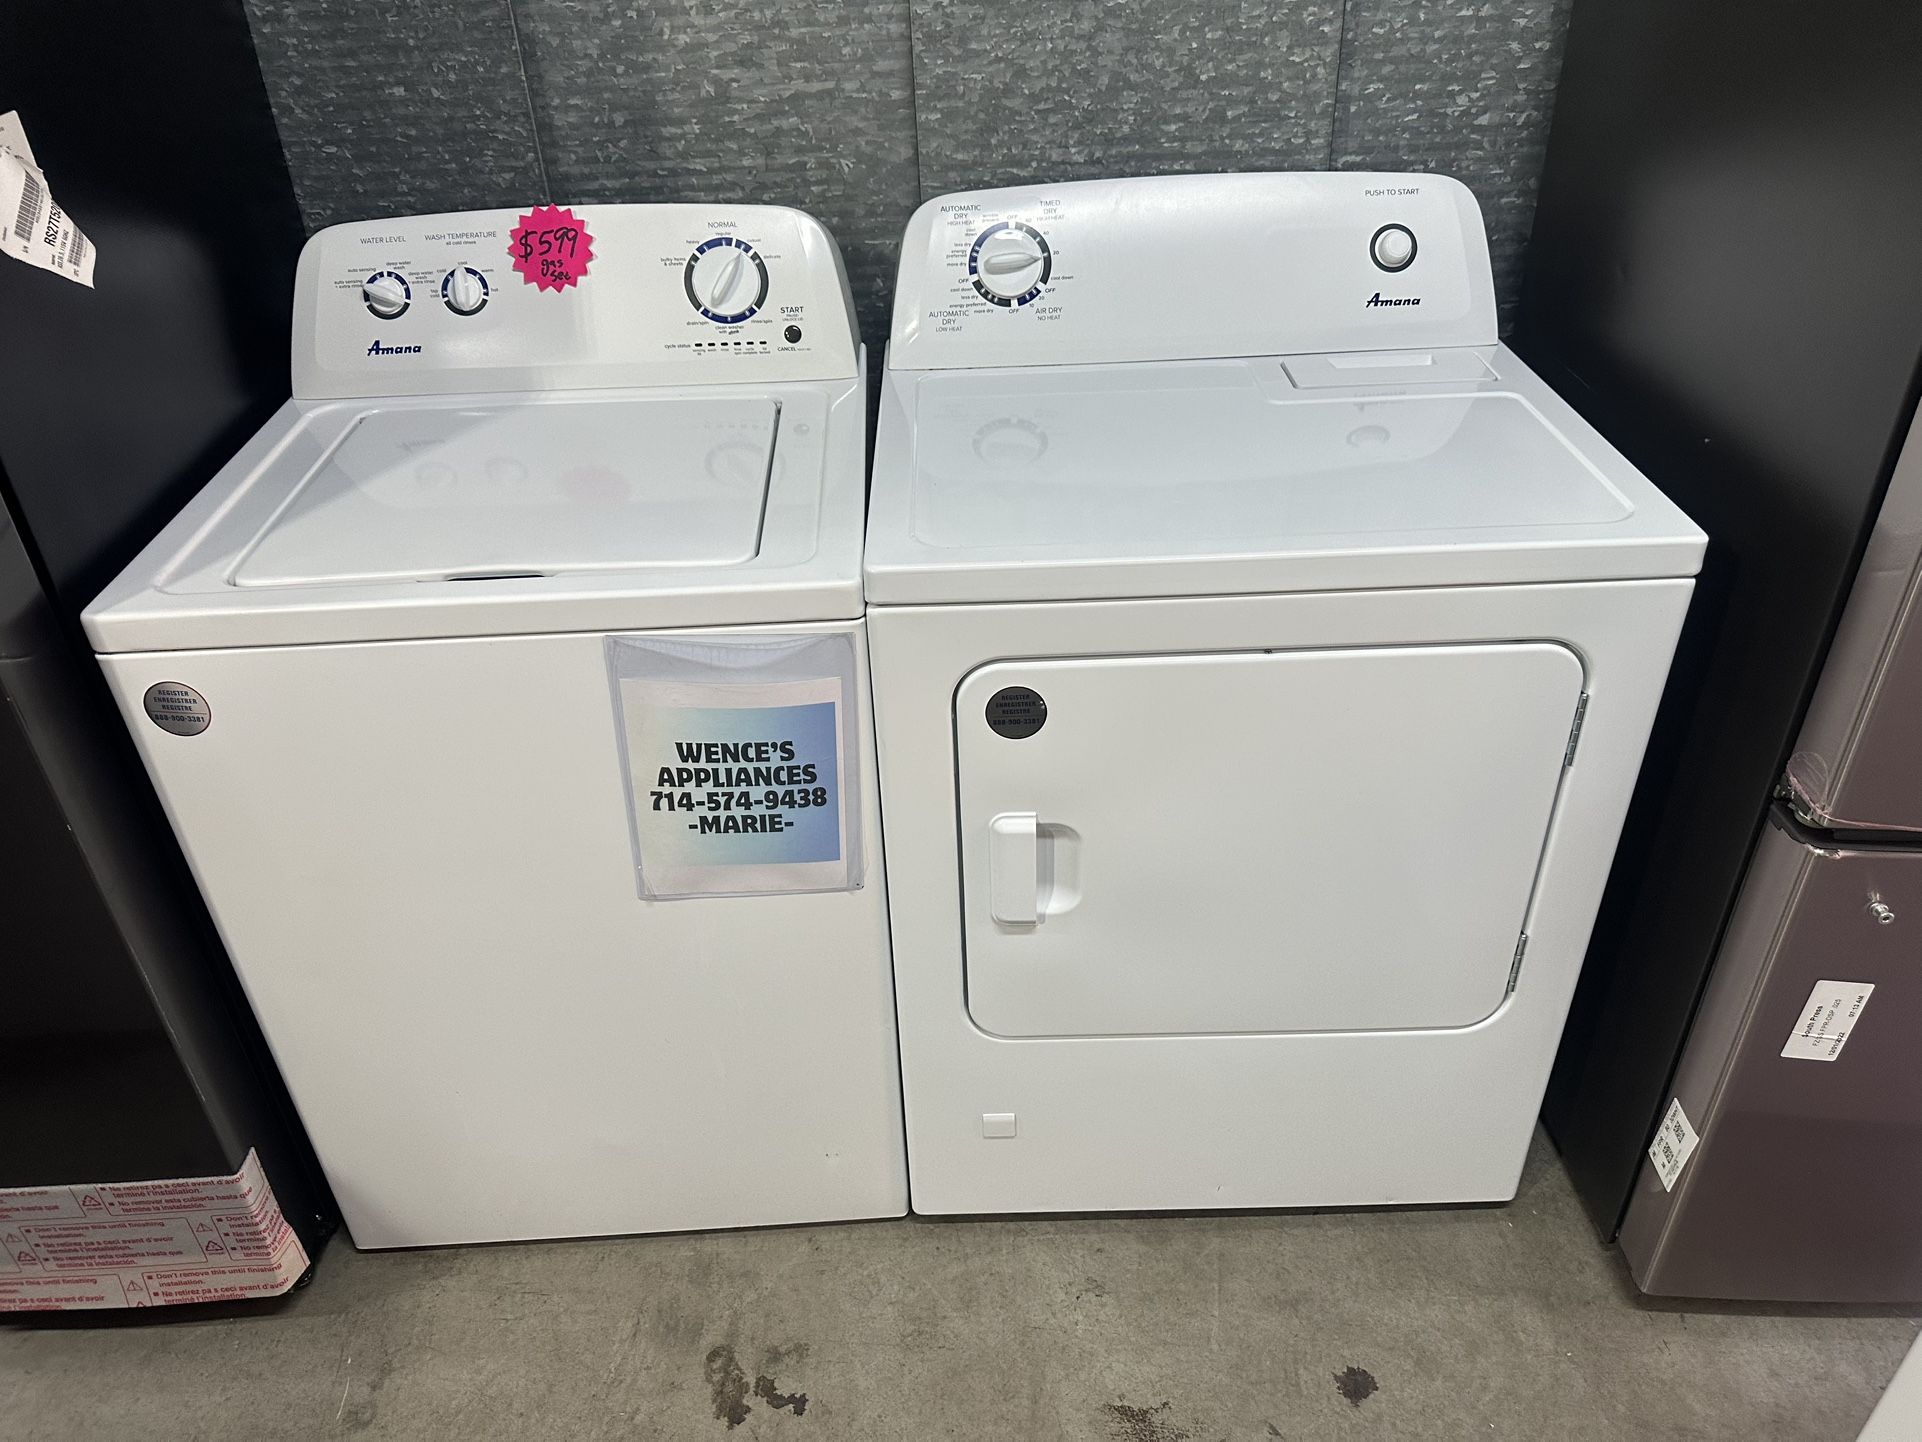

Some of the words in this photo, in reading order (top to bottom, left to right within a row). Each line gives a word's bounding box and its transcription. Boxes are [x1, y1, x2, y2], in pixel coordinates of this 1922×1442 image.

[1364, 189, 1385, 197] PUSH
[448, 231, 497, 240] TEMPERATURE
[518, 226, 579, 263] $599
[540, 258, 564, 277] gas
[550, 270, 571, 282] set
[1365, 292, 1421, 308] Amana
[928, 310, 970, 318] AUTOMATIC
[367, 339, 422, 357] Amana
[675, 740, 795, 764] WENCE'S
[657, 763, 817, 788] APPLIANCES
[650, 786, 827, 812] 714-574-9438
[688, 813, 794, 835] -MARIE-
[1810, 1005, 1823, 1022] Press
[228, 1267, 246, 1275] until
[175, 1289, 200, 1297] retirez
